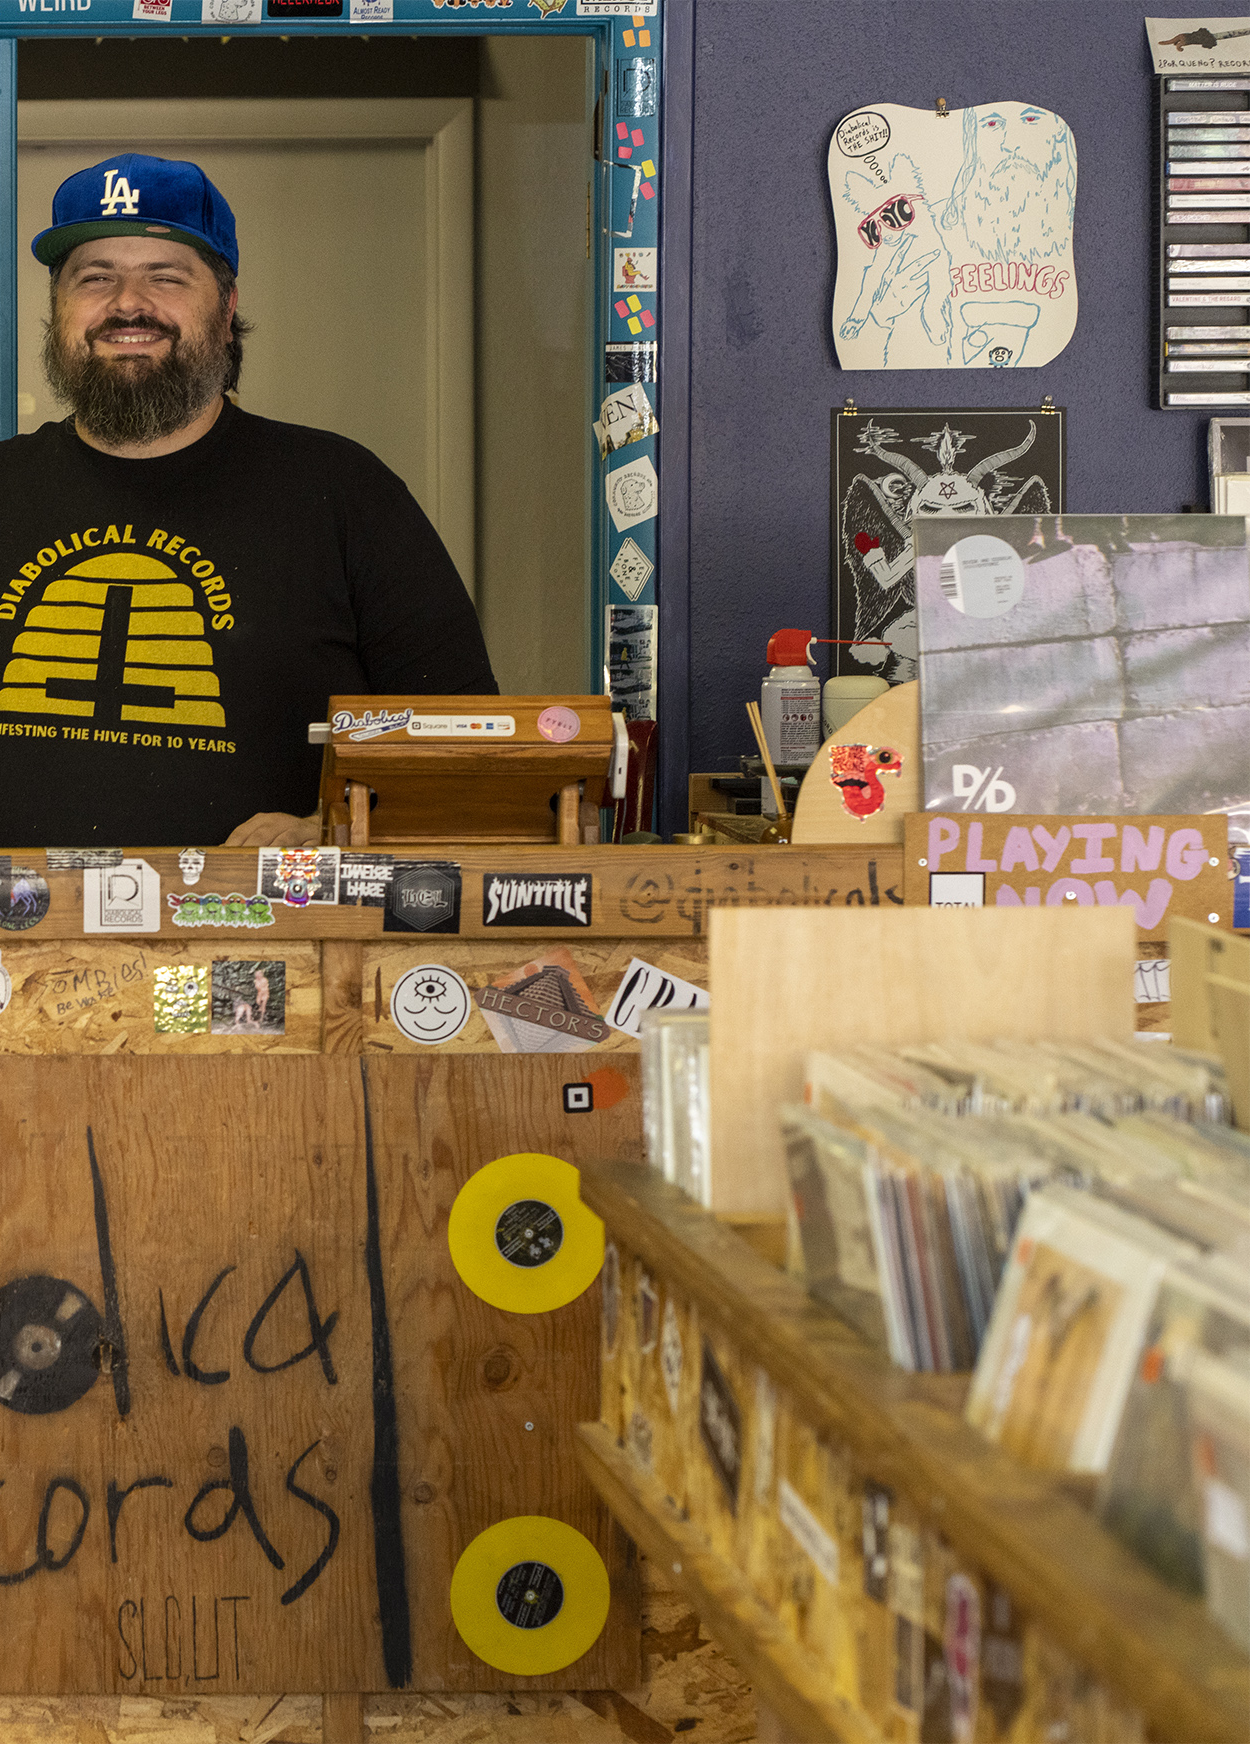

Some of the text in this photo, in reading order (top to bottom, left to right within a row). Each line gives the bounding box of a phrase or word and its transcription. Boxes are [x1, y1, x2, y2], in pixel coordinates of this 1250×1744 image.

[353, 6, 390, 15] ALMOST READY
[838, 117, 872, 139] Diabolical
[843, 124, 880, 146] Records is
[847, 128, 889, 153] THE SHIT!!
[100, 169, 140, 216] LA
[950, 261, 1070, 300] FEELINGS
[145, 528, 236, 631] RECORDS
[622, 558, 631, 580] BONE
[334, 709, 412, 733] Diabolical
[61, 726, 90, 740] THE
[93, 728, 129, 745] HIVE
[132, 733, 163, 748] FOR
[166, 735, 184, 749] 10
[187, 736, 237, 754] YEARS
[927, 816, 1210, 881] PLAYING
[486, 876, 589, 925] SUNTITLE
[996, 877, 1173, 930] NOW
[104, 915, 143, 924] RECORDS
[480, 989, 604, 1042] HECTOR'S
